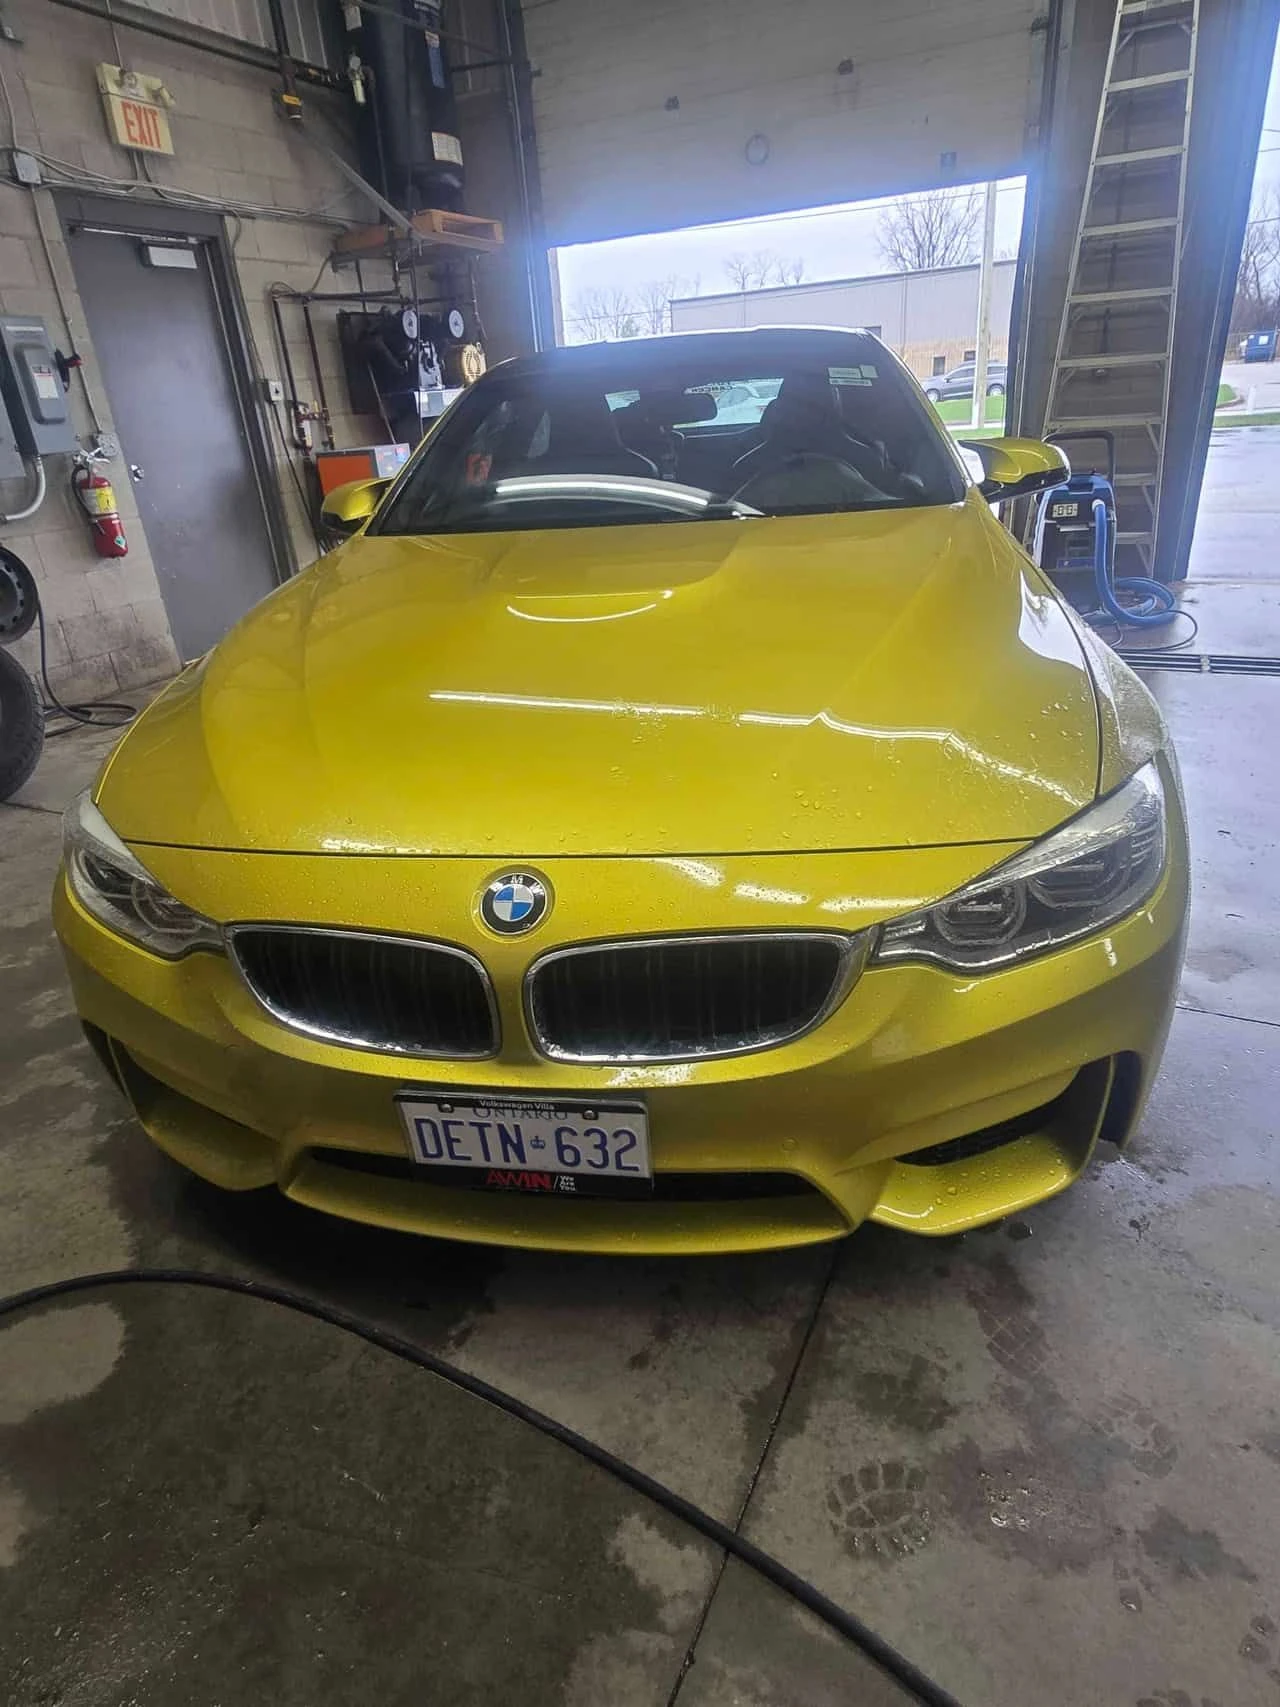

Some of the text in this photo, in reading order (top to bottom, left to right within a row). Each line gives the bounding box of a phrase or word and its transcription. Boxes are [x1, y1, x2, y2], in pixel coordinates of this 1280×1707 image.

[121, 101, 161, 148] EXIT
[480, 1100, 533, 1109] Volkswagen
[414, 1117, 640, 1172] DETN 632
